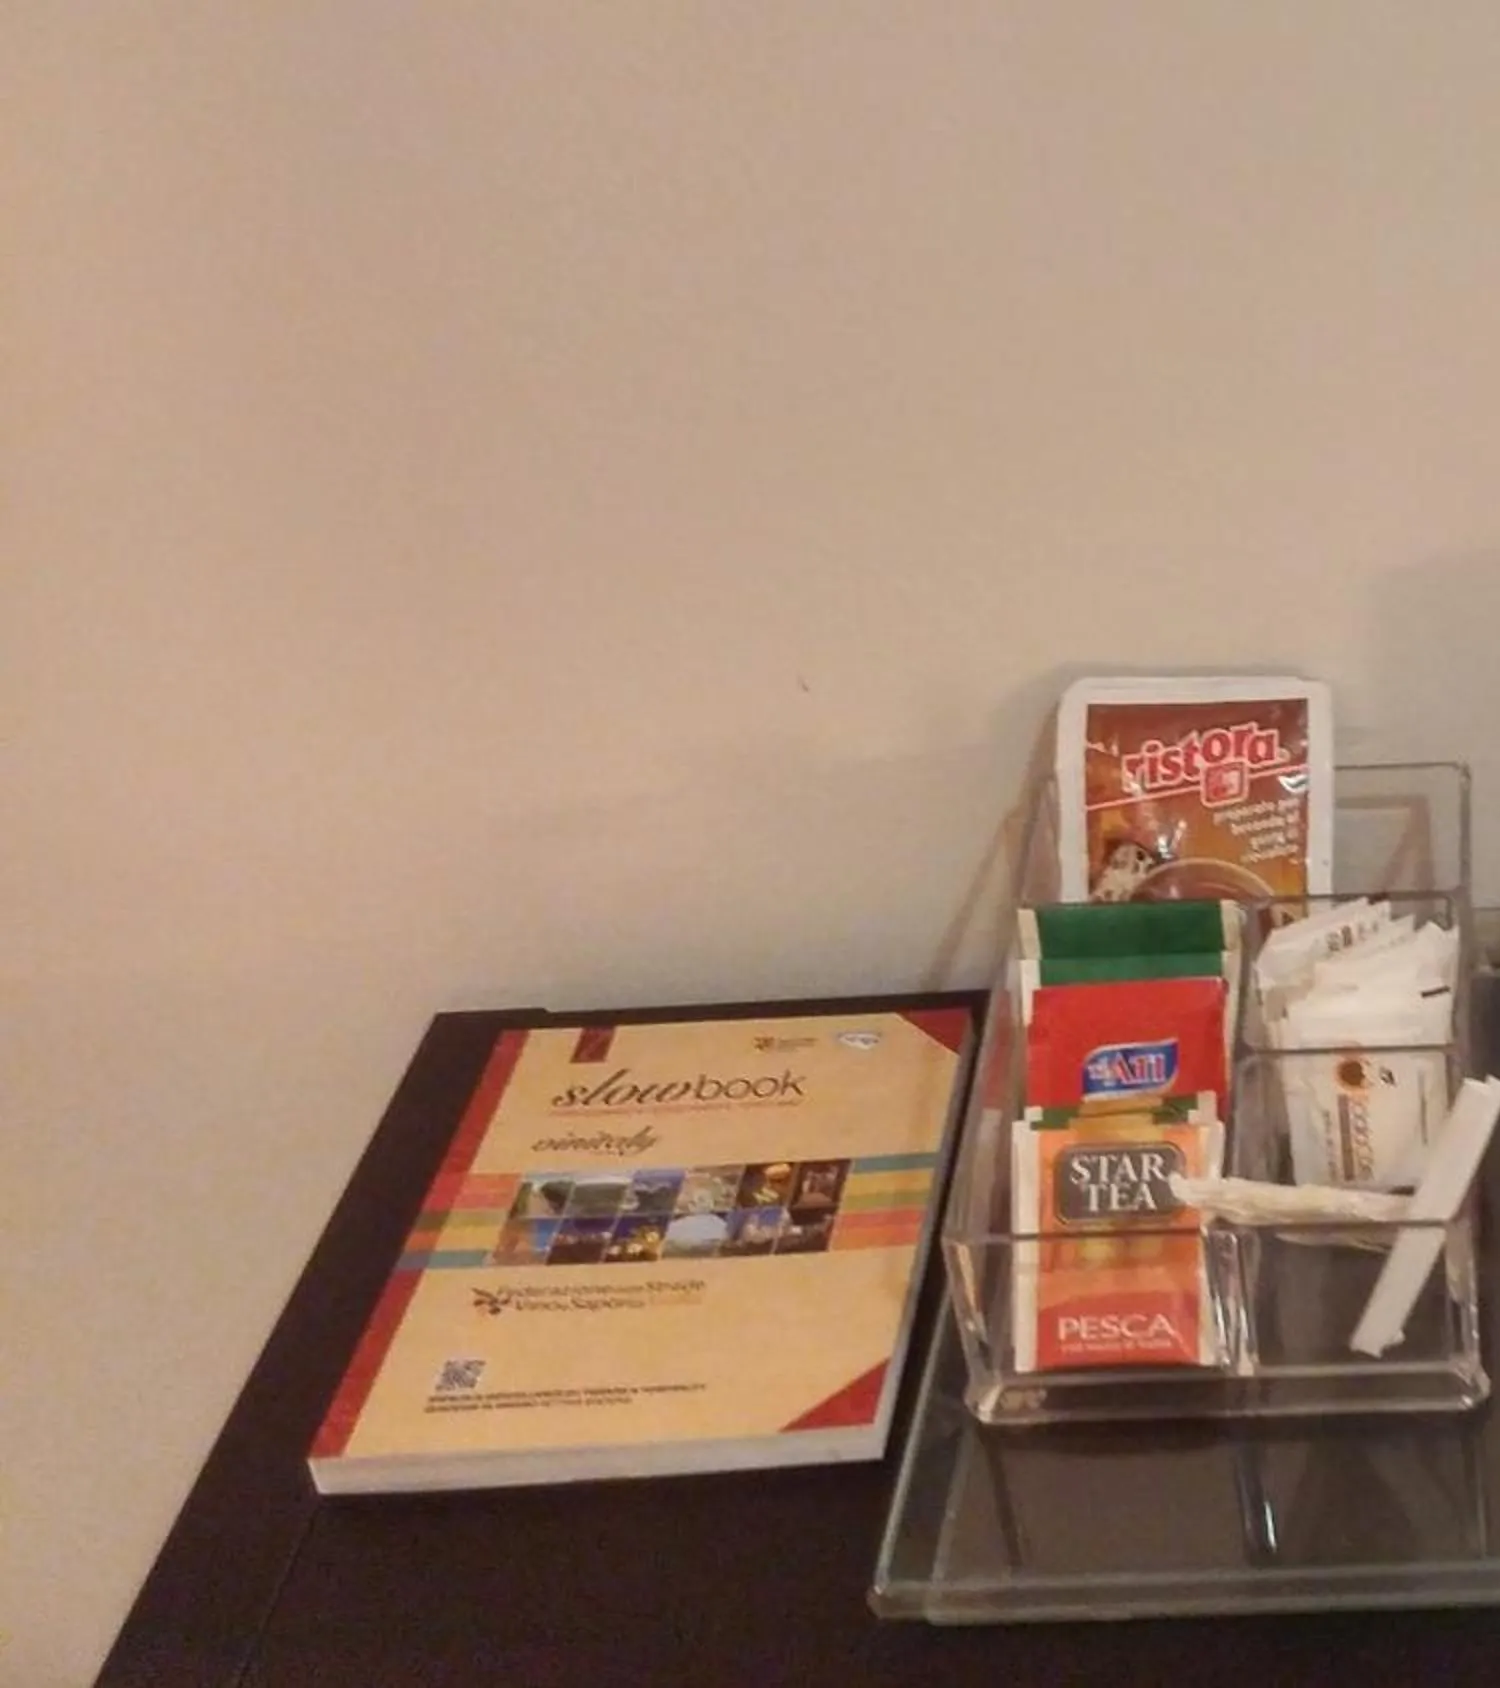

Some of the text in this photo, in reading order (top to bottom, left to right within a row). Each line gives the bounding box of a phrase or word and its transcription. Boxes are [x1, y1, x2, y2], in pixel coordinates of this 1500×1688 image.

[1122, 721, 1280, 790] ristora
[551, 1067, 807, 1107] slowbook
[1069, 1151, 1169, 1185] STAR
[1082, 1180, 1158, 1213] TEA
[1058, 1313, 1177, 1341] PESCA
